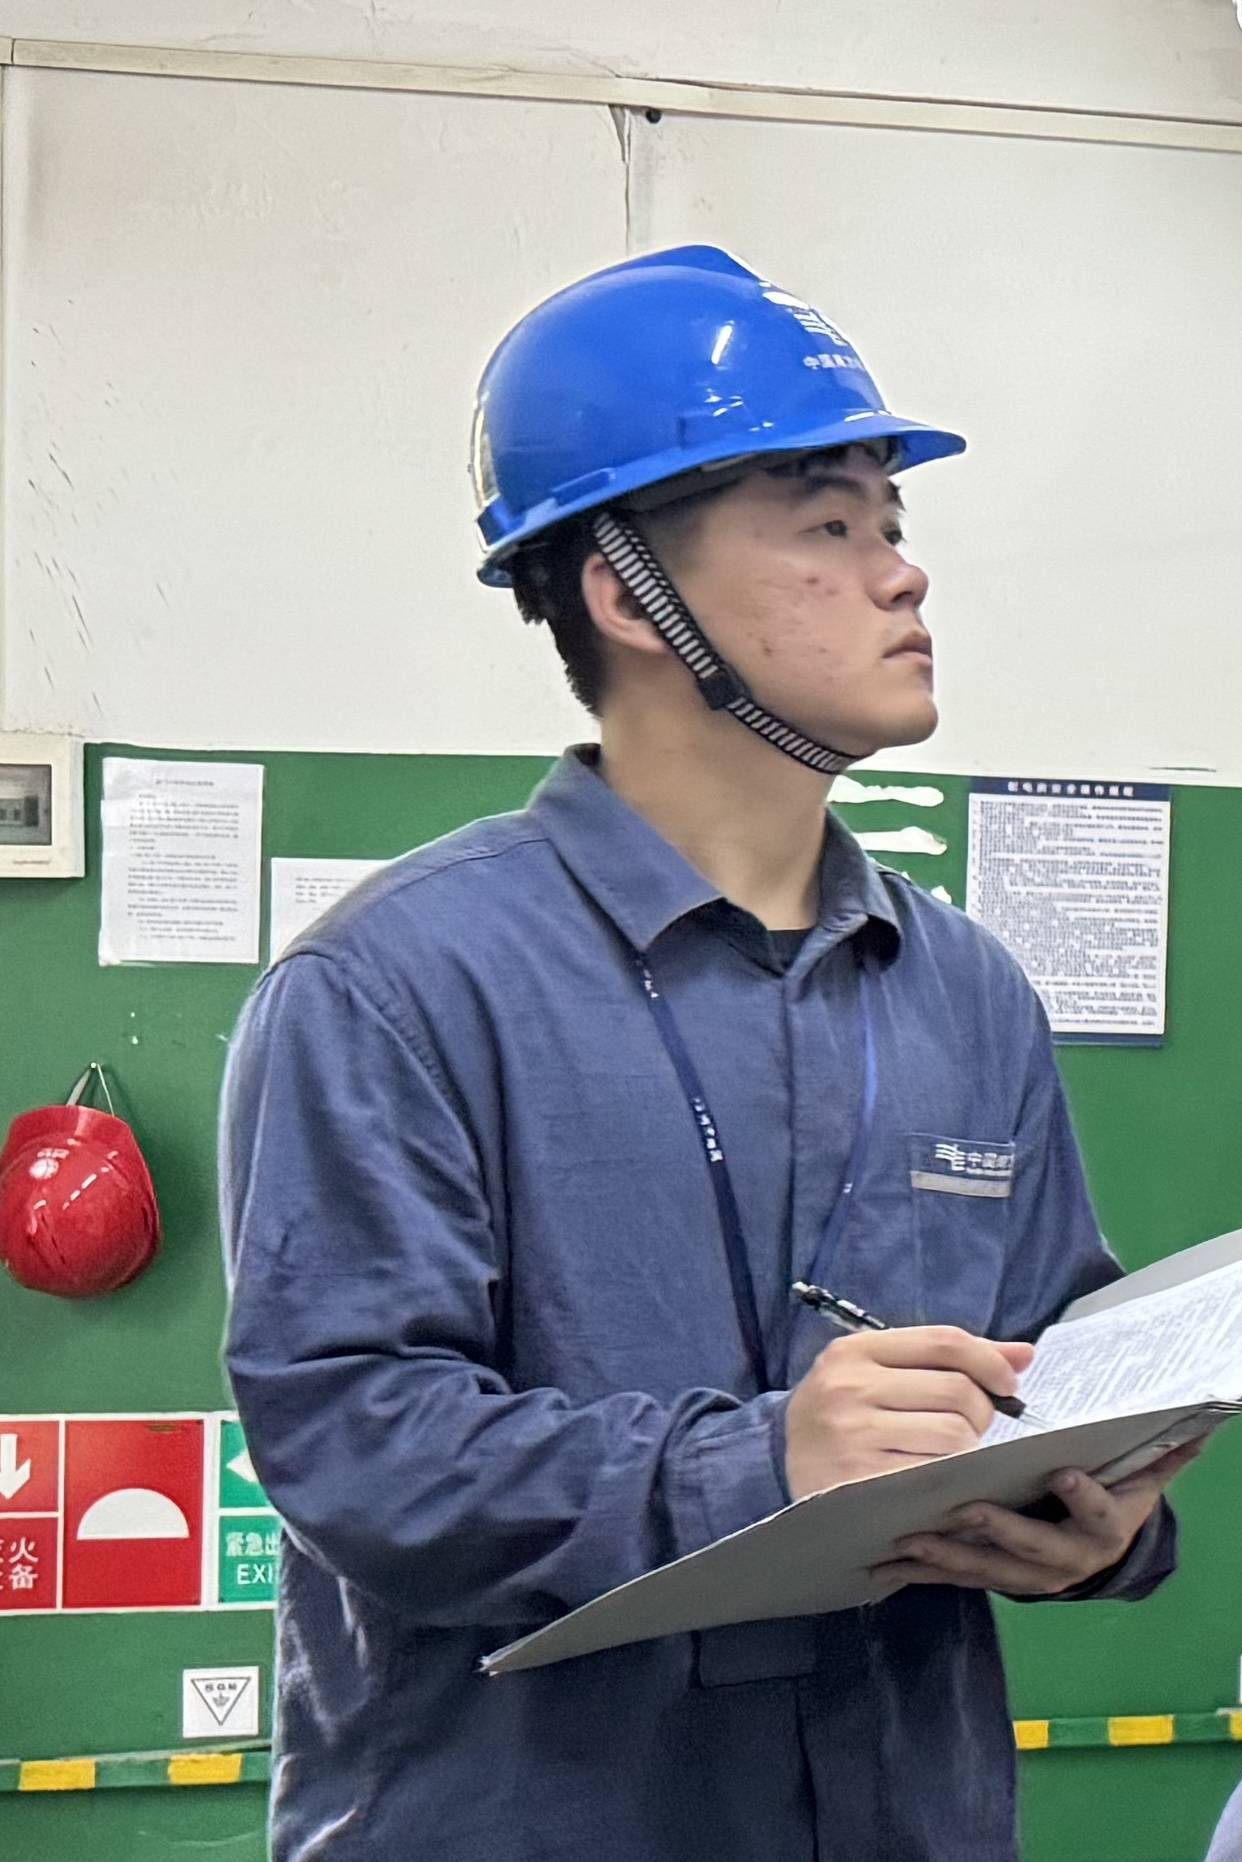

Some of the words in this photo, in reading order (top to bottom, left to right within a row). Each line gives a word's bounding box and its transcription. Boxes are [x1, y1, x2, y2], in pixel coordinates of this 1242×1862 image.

[0, 1536, 39, 1563] 火
[226, 1531, 279, 1557] 紧急出
[0, 1563, 39, 1590] 备
[237, 1562, 273, 1585] EXI
